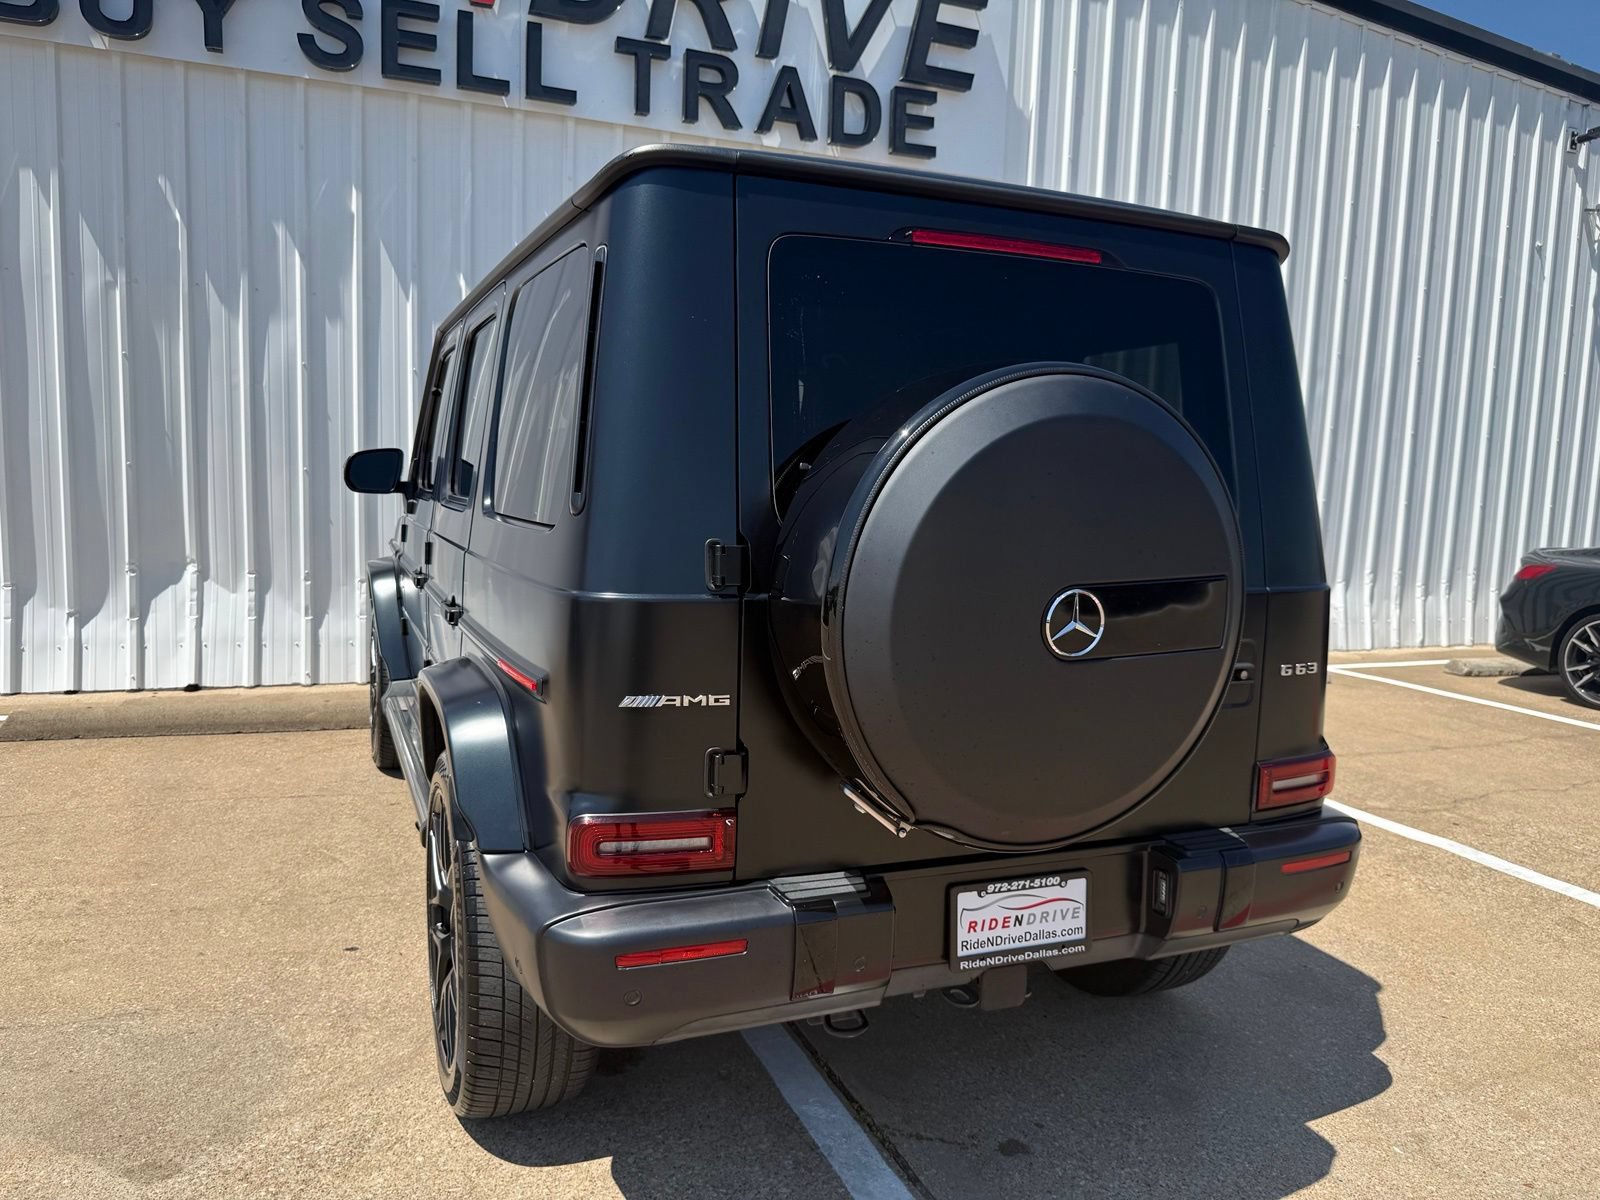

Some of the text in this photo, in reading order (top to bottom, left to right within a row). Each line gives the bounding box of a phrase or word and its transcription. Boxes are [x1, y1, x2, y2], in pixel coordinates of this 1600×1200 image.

[296, 0, 578, 106] SELL
[614, 36, 938, 160] TRADE
[655, 694, 731, 707] AMG
[986, 876, 1061, 894] 972-271-5100
[960, 926, 1084, 952] RideNDriveDallas.com
[959, 943, 1086, 971] RideNDriveDallas.com
